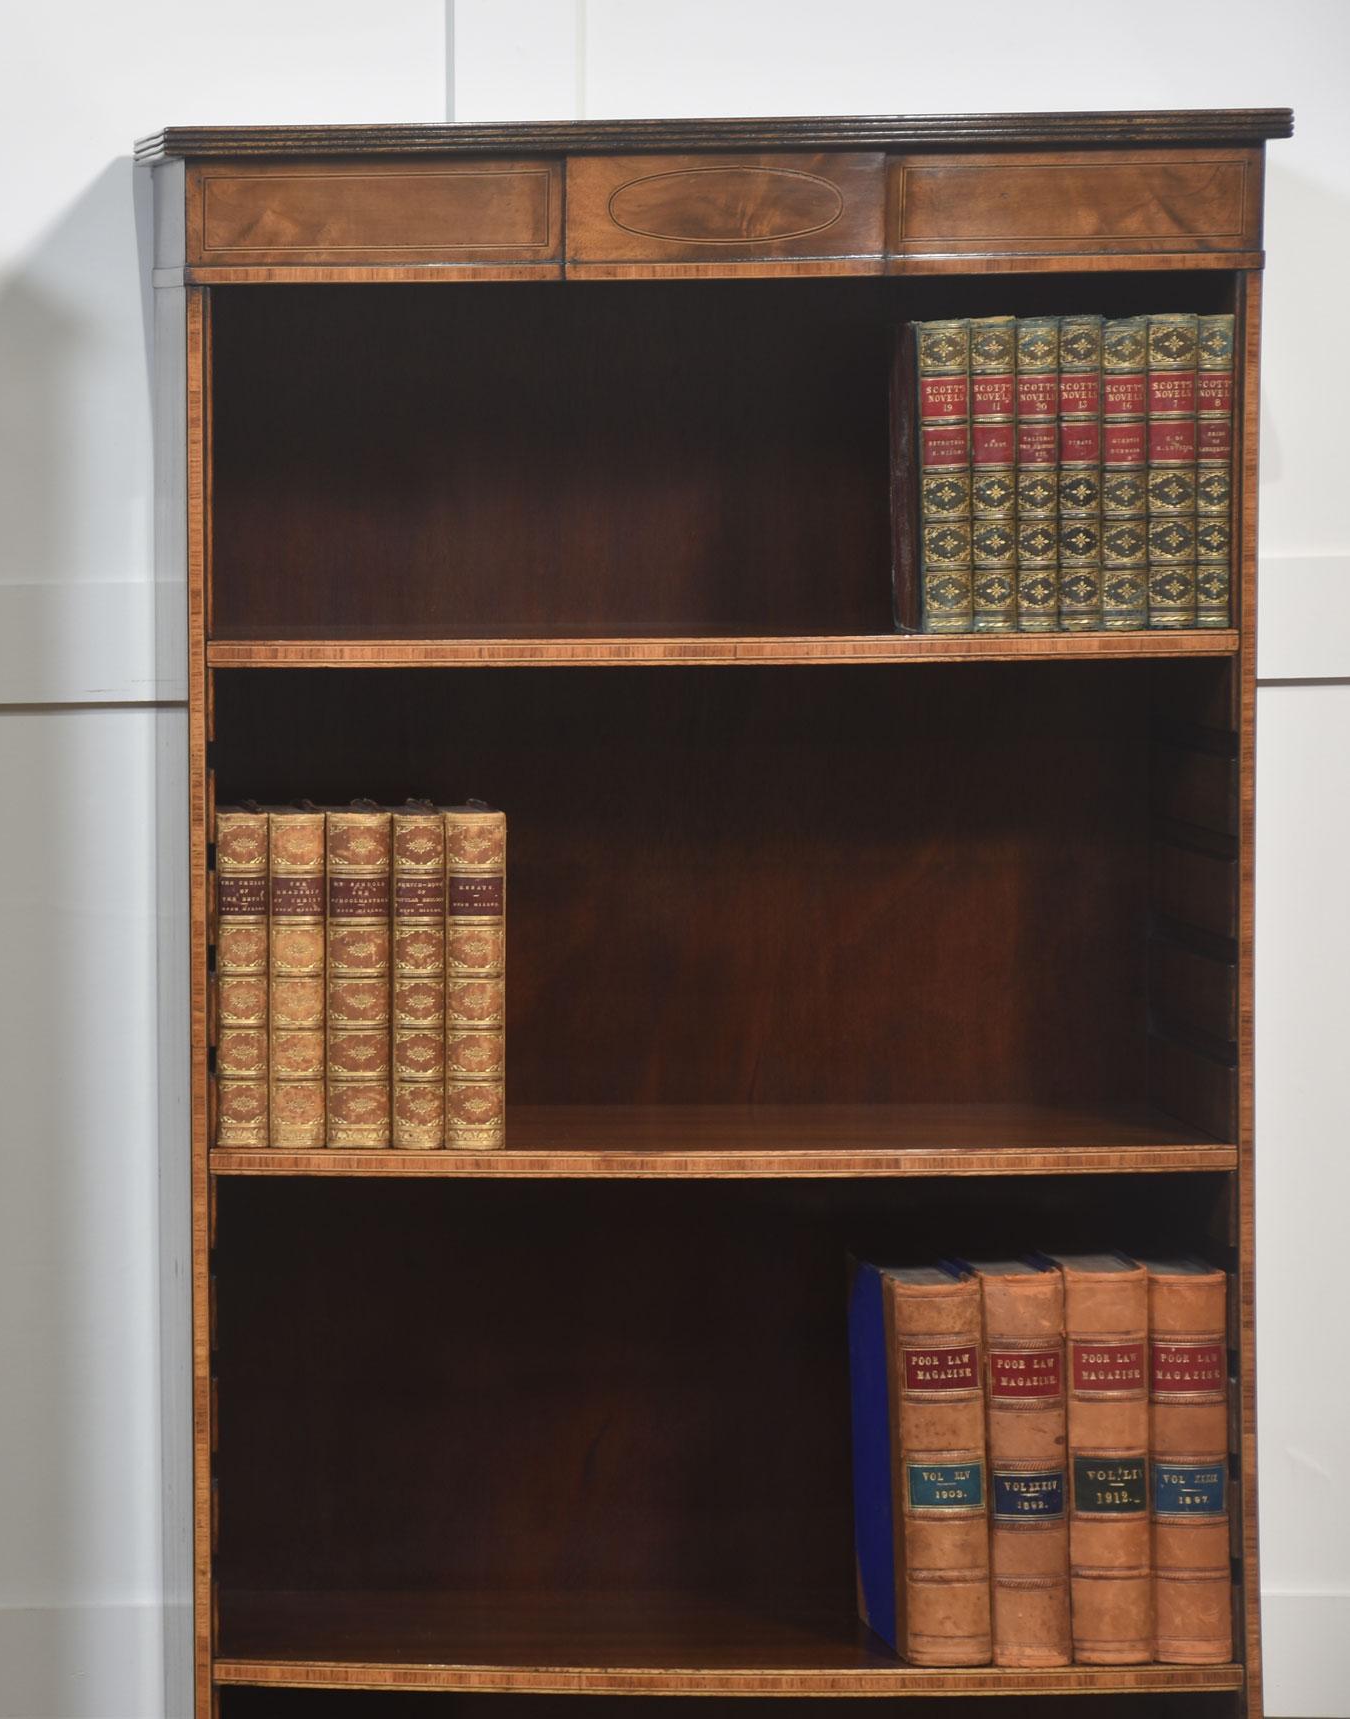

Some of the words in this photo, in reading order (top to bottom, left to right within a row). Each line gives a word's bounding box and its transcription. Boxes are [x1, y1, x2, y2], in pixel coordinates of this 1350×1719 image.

[943, 404, 952, 412] 19
[911, 1356, 939, 1366] POOR
[948, 1354, 970, 1365] LAW
[1081, 1354, 1110, 1363] POOR
[1116, 1353, 1138, 1363] LAW
[1160, 1353, 1190, 1363] POOR
[1198, 1353, 1218, 1363] LAW
[997, 1359, 1026, 1369] POOR
[1033, 1359, 1055, 1369] LAW
[917, 1368, 972, 1380] MAGAZINE
[1082, 1370, 1141, 1380] MAGAZINE
[1156, 1370, 1220, 1380] MAGAZINE
[922, 1472, 944, 1481] VOL
[1162, 1474, 1186, 1484] VOL
[1004, 1482, 1026, 1492] VOL
